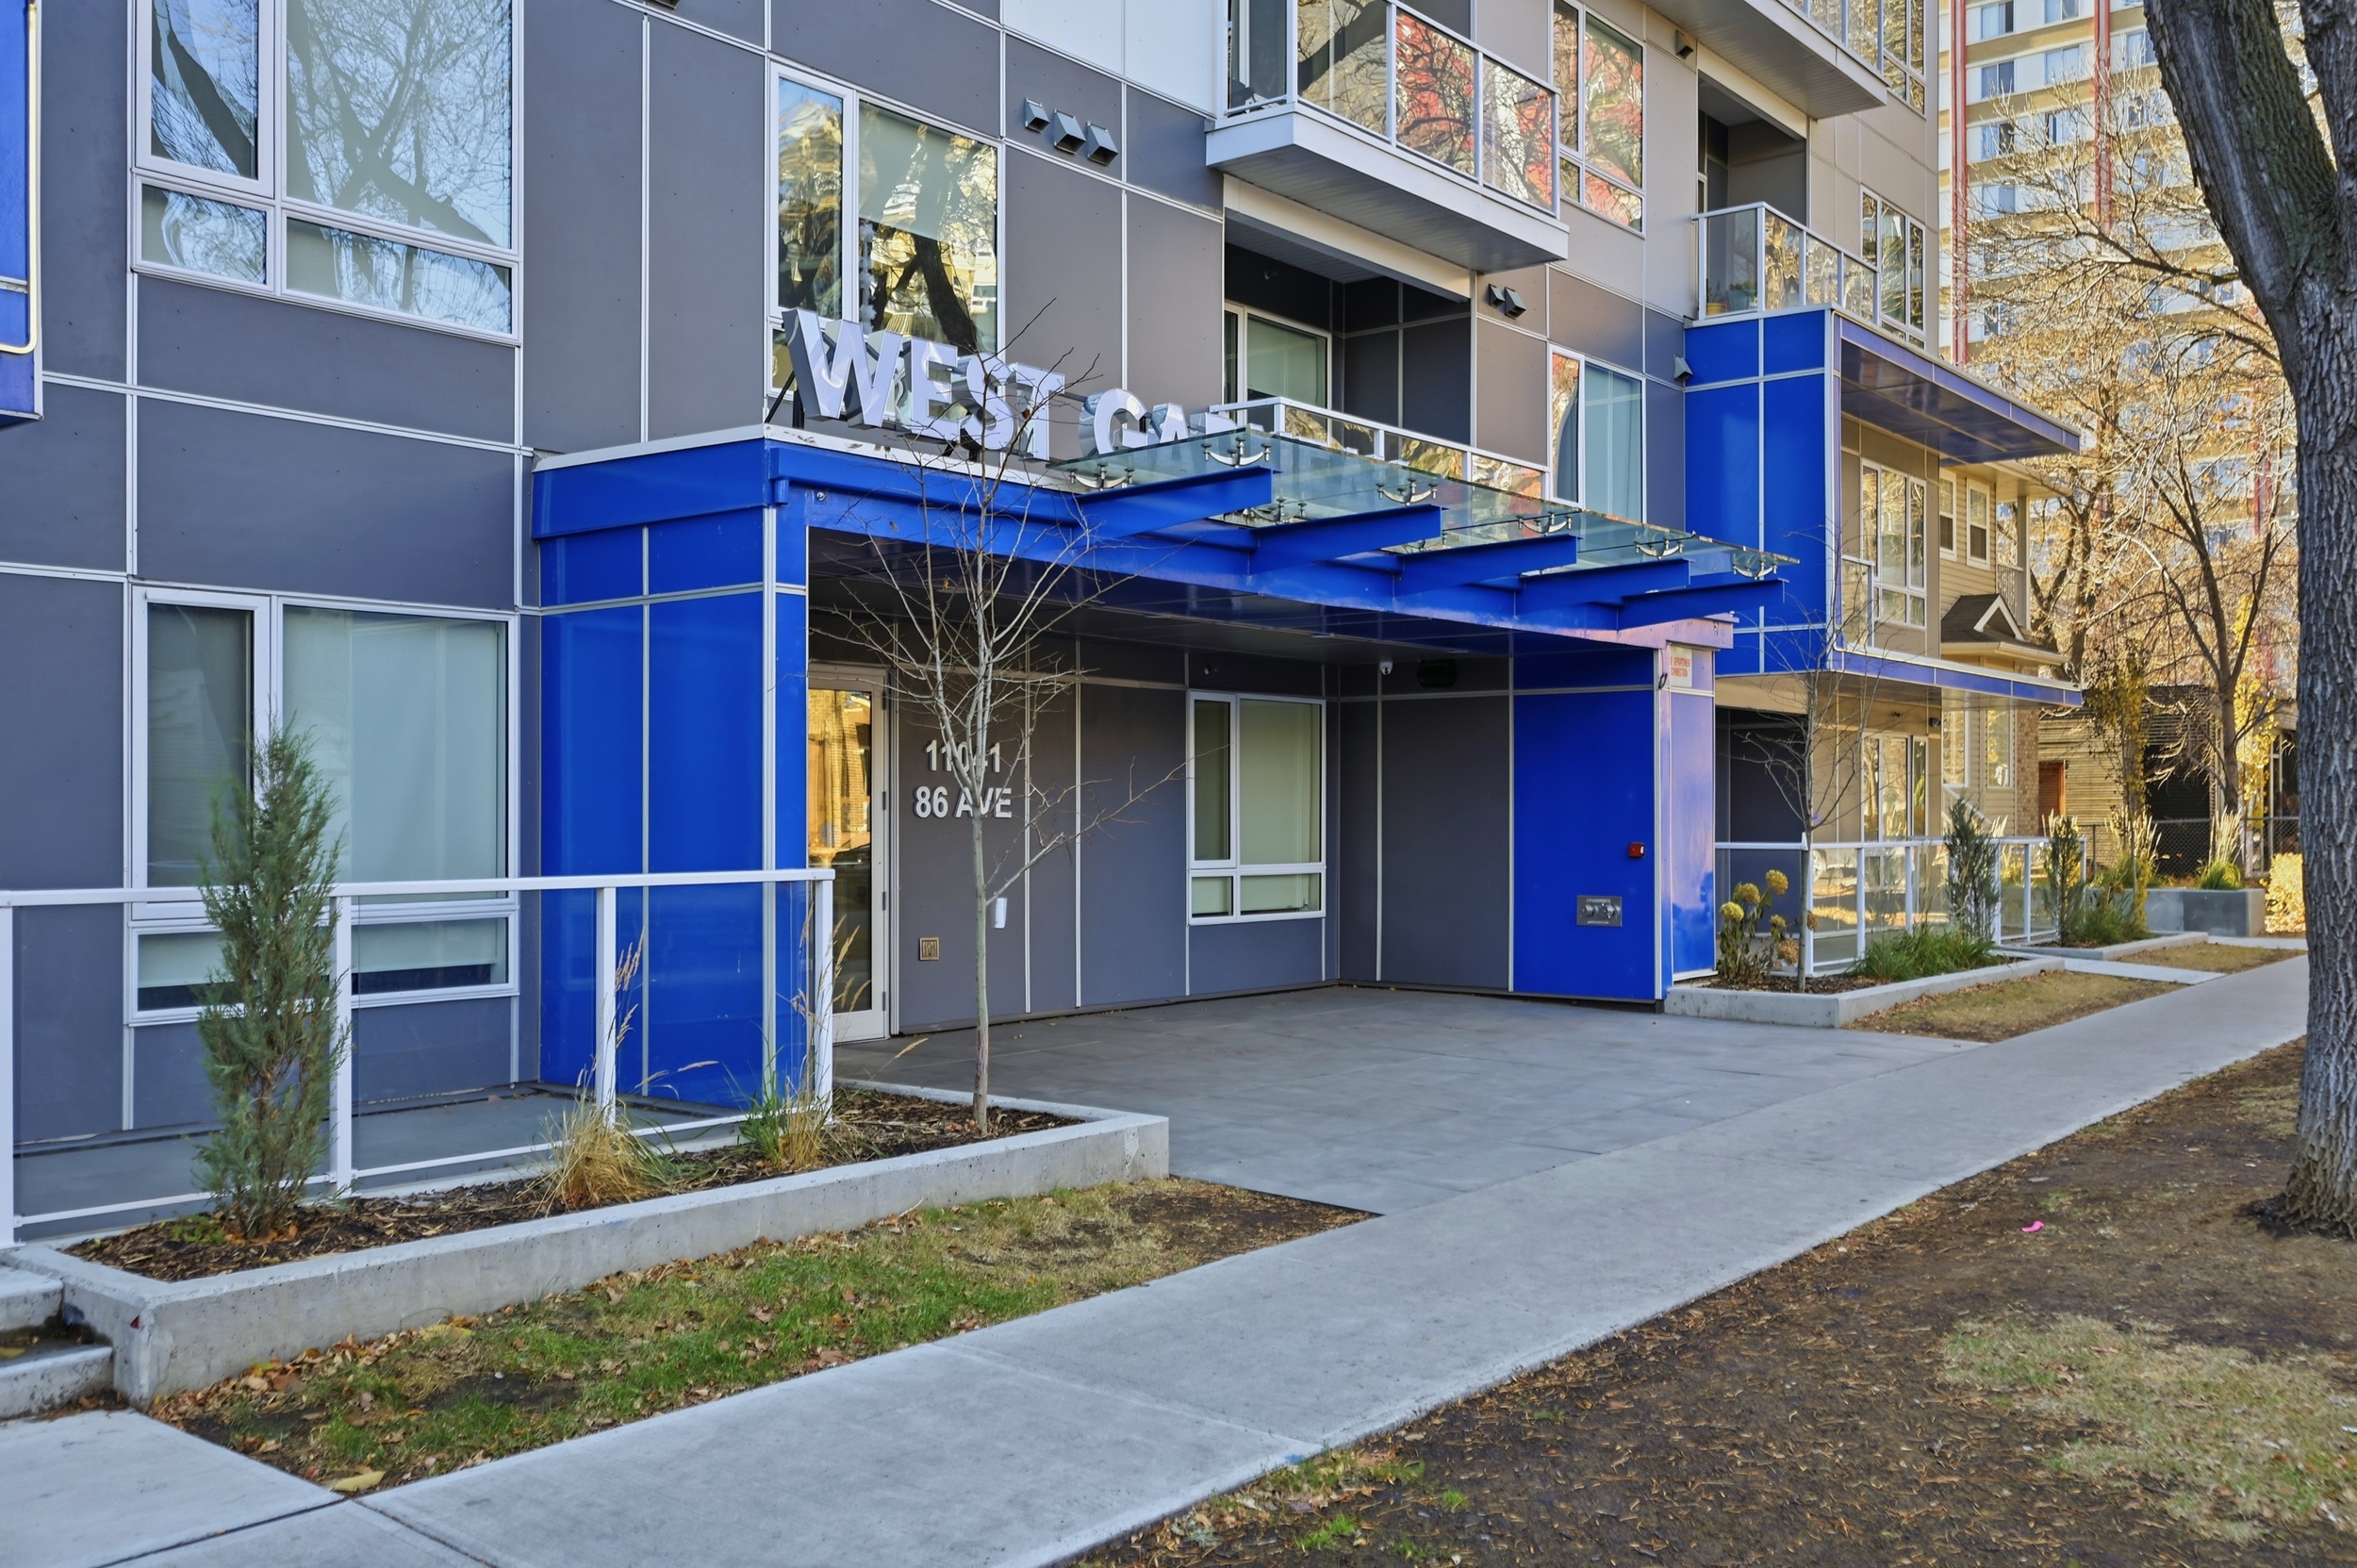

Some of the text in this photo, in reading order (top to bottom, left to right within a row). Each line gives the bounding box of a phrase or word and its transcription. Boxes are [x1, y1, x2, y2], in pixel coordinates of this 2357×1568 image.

[782, 308, 1065, 461] WEST
[915, 785, 1013, 818] 86 AVE
